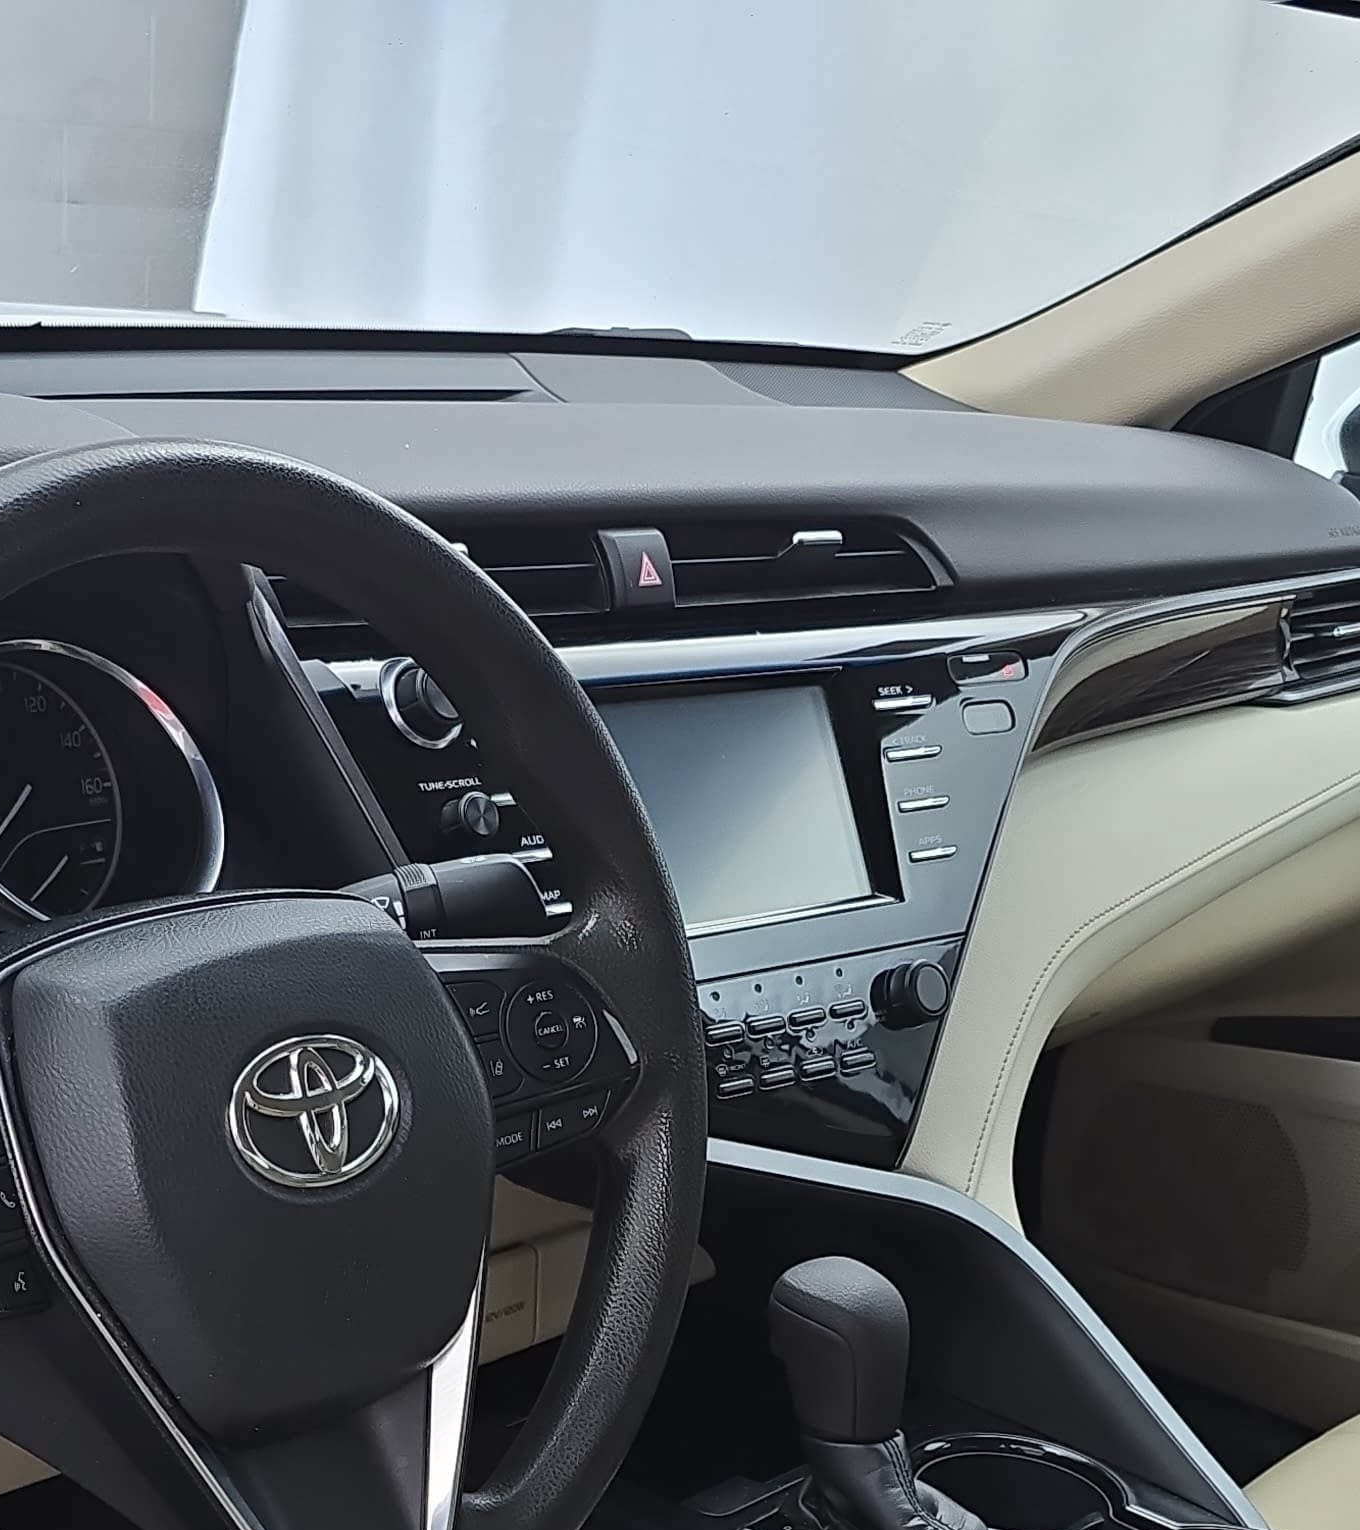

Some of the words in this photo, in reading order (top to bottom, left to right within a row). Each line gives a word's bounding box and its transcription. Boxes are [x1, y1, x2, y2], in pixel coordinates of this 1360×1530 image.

[878, 687, 902, 697] SEEK
[24, 697, 47, 713] 120
[60, 731, 81, 748] 140
[81, 777, 103, 795] 160
[419, 928, 437, 940] INT
[496, 1132, 524, 1148] MODE
